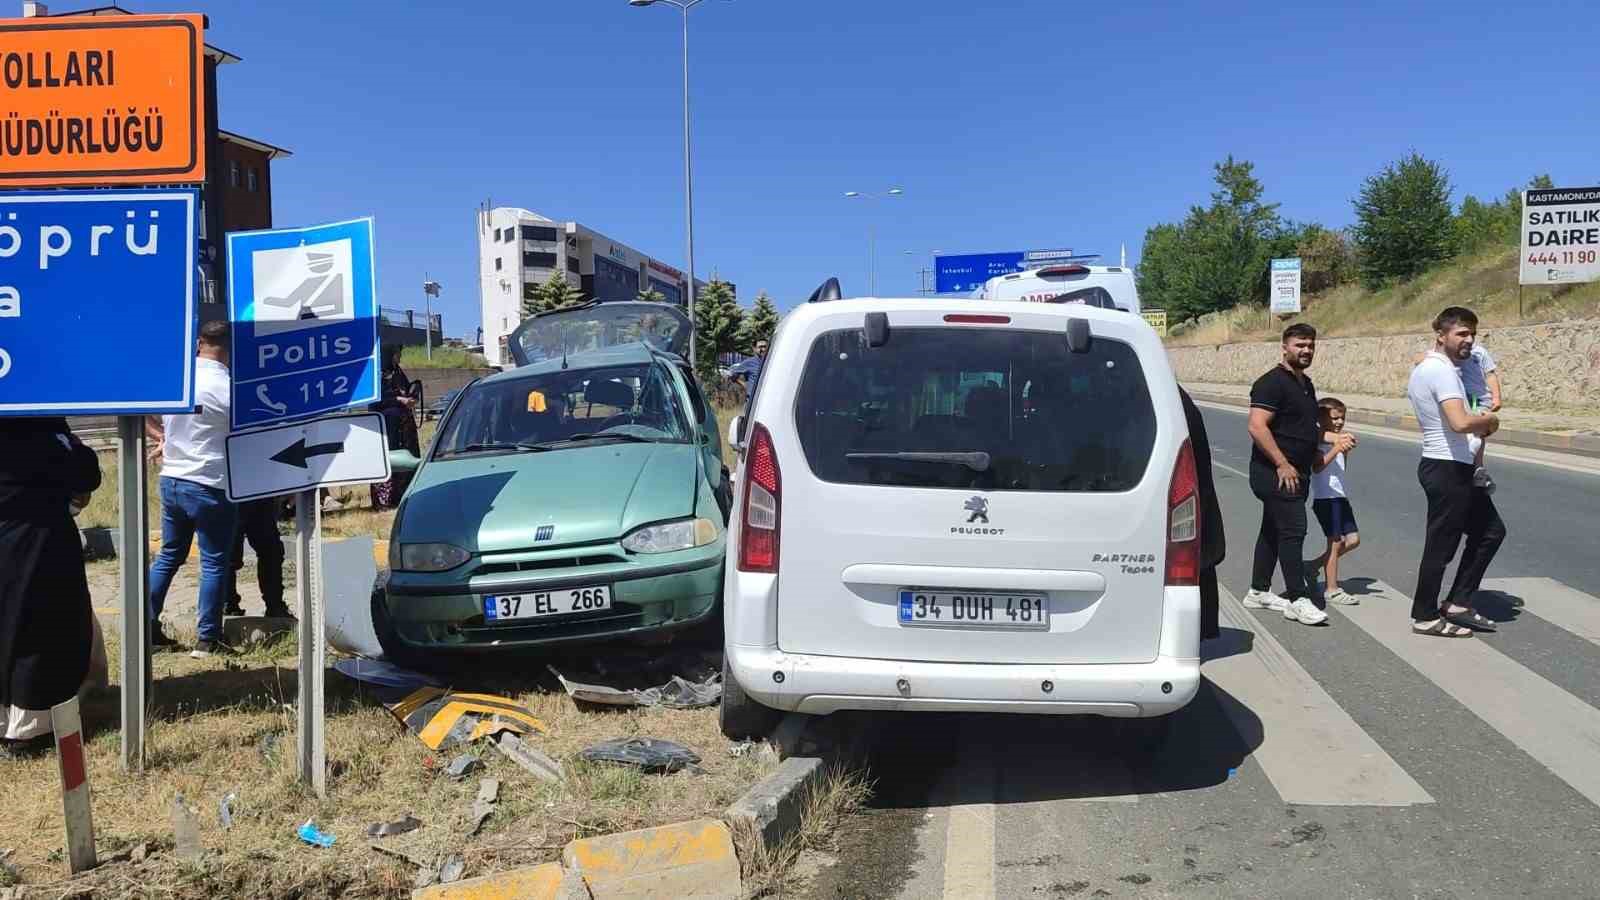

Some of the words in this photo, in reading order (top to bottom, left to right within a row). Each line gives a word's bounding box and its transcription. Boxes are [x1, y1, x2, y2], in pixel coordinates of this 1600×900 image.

[0, 50, 114, 89] OLLARI
[0, 106, 163, 156] ÜDÜRLÜĞÜ
[1528, 208, 1600, 225] SATILIK
[1528, 252, 1557, 265] 444
[1562, 251, 1574, 264] 11
[1578, 250, 1596, 263] 90
[258, 334, 352, 369] Polis
[300, 375, 349, 404] 112
[950, 527, 1005, 536] PEUGEOT
[1091, 553, 1156, 564] PARTNER
[500, 597, 521, 617] 37
[535, 592, 558, 615] EL
[570, 588, 605, 611] 266
[914, 595, 942, 619] 34
[952, 595, 993, 621] DUH
[1005, 597, 1043, 622] 481
